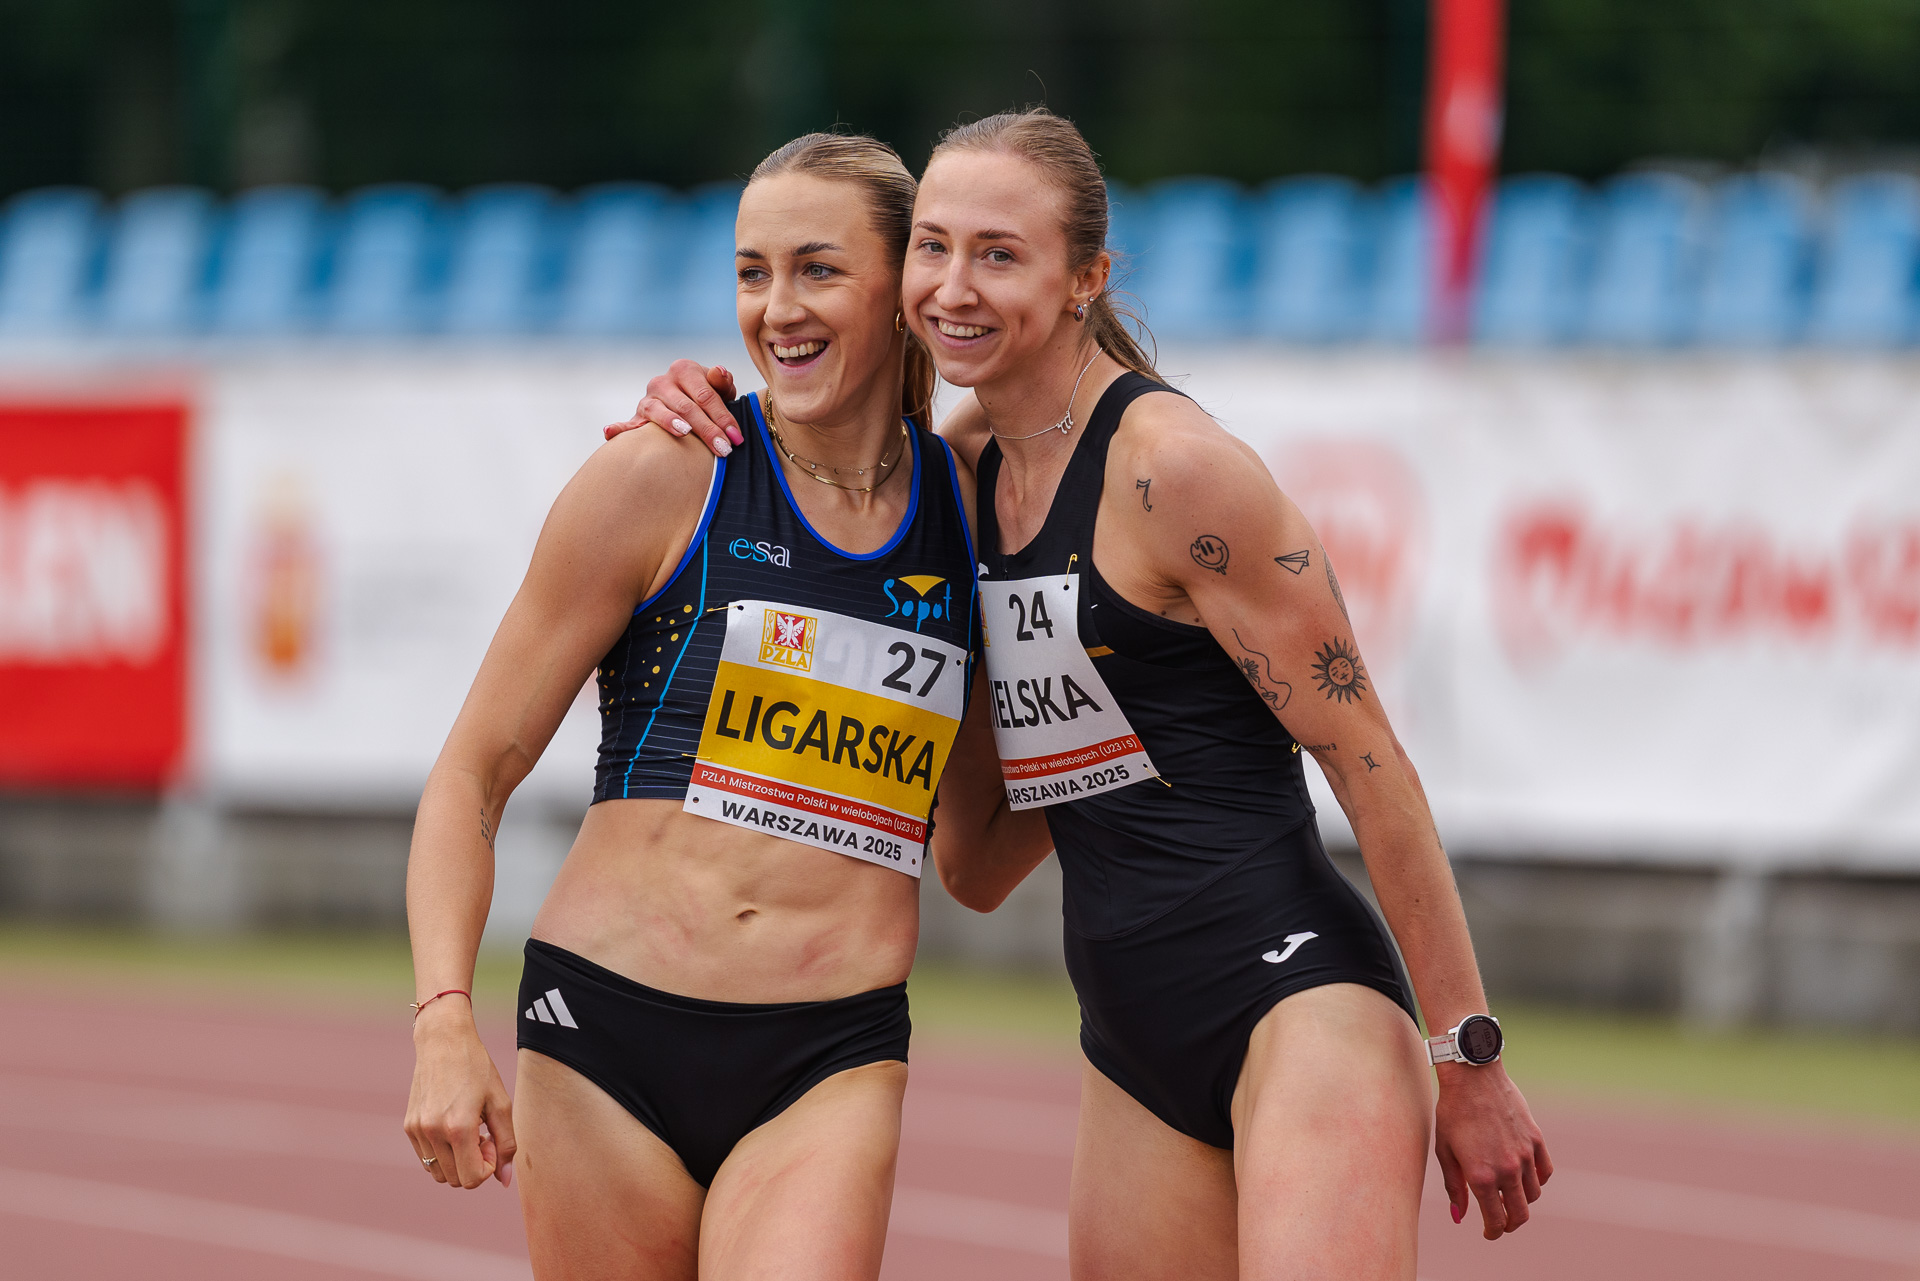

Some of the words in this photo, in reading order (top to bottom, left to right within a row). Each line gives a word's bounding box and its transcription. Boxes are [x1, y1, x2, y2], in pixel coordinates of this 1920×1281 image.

[883, 578, 952, 632] Sopot
[1008, 590, 1054, 642] 24
[761, 644, 808, 669] PZLA
[881, 641, 947, 698] 27
[989, 674, 1104, 729] IELSKA
[715, 689, 935, 792] LIGARSKA
[1020, 761, 1040, 773] Polski
[1040, 762, 1048, 770] w
[1048, 750, 1099, 769] wielobojach
[1098, 741, 1122, 757] (U23
[701, 769, 726, 785] PZLA
[728, 776, 795, 801] Mistrzostwa
[796, 793, 829, 809] Polski
[829, 802, 840, 812] w
[841, 805, 893, 827] wielobojach
[893, 817, 910, 834] (U23
[914, 825, 923, 838] S)
[1081, 764, 1130, 790] 2025
[722, 799, 858, 850] WARSZAWA
[862, 835, 902, 861] 2025
